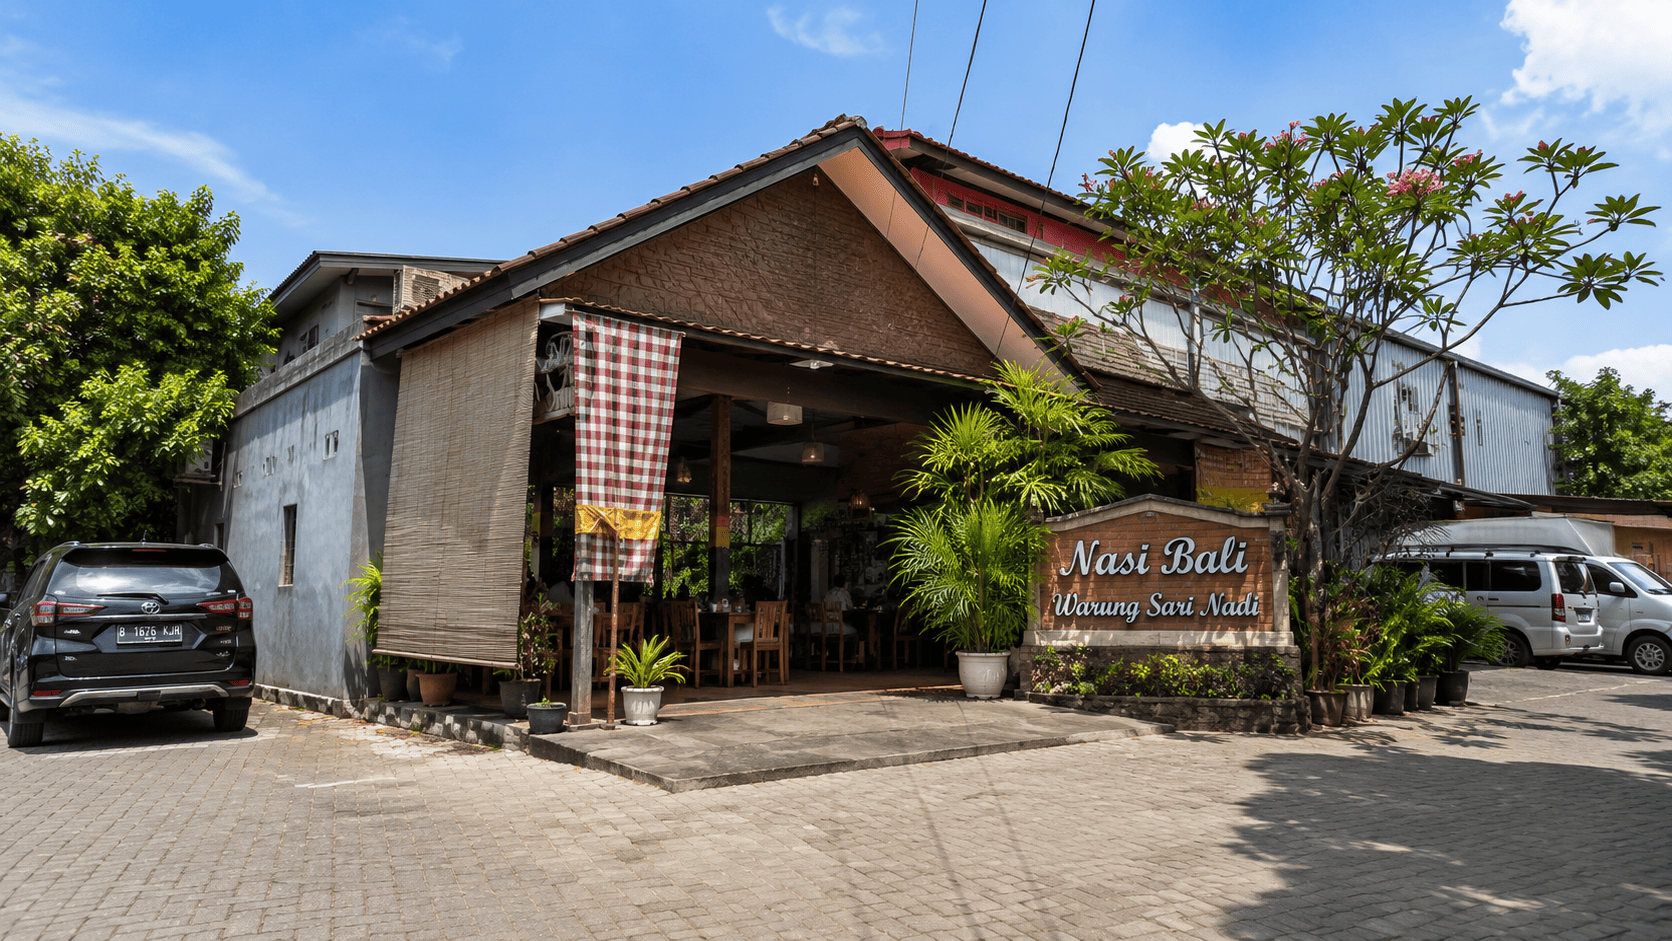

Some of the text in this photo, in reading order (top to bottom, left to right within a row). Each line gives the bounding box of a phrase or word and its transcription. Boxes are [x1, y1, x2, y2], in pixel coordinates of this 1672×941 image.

[1059, 535, 1249, 576] Nasi Bali
[1053, 592, 1260, 624] Warung Sari Nadi
